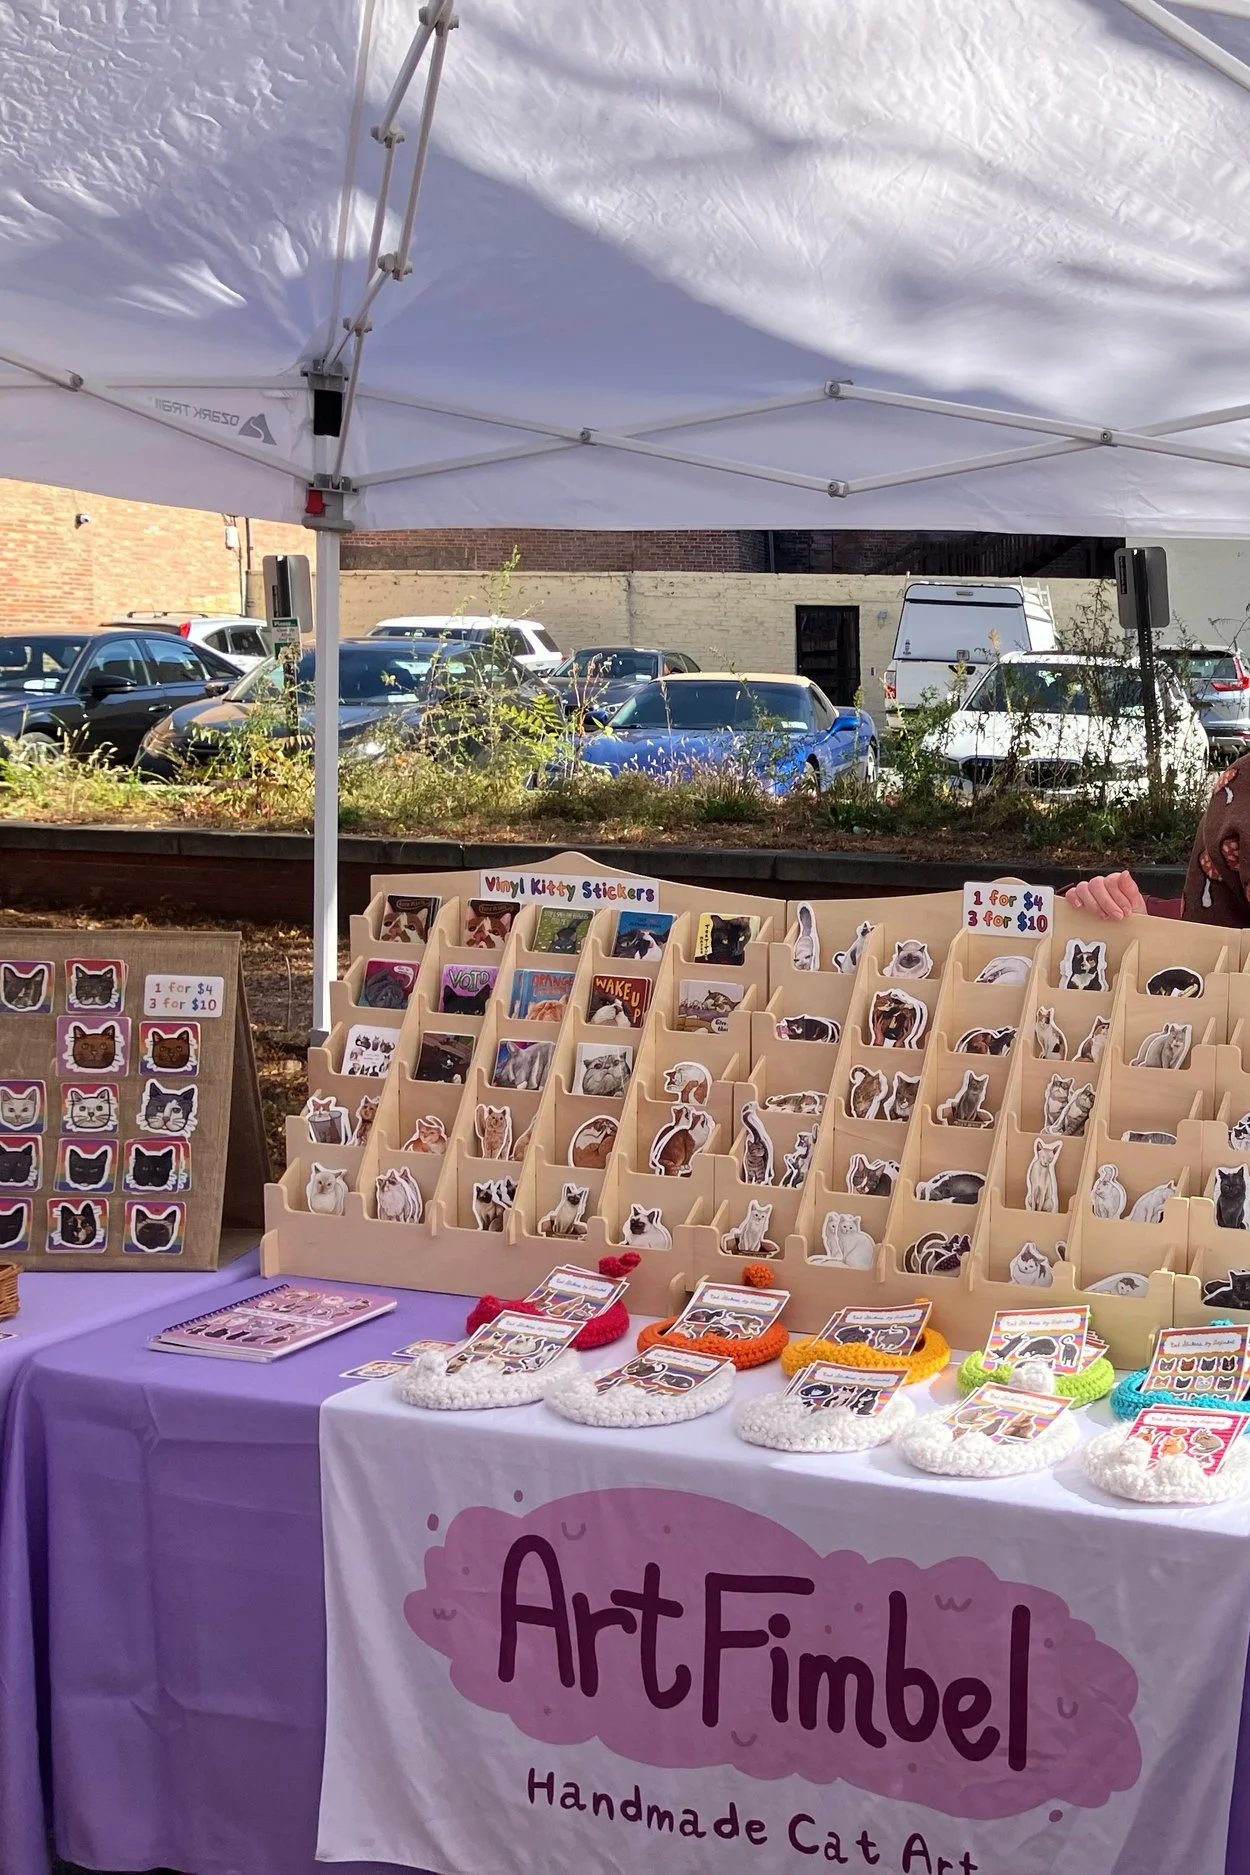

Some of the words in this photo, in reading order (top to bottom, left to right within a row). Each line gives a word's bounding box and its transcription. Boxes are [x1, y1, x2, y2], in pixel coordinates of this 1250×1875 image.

[484, 876, 525, 898] Vinyl
[531, 877, 576, 902] Kitty
[582, 881, 655, 902] Stickers
[973, 890, 983, 906] 1
[989, 889, 1017, 907] for
[1023, 891, 1044, 912] $4
[967, 910, 978, 926] 3
[983, 910, 1012, 928] for
[1017, 911, 1048, 933] $10
[155, 983, 162, 993] 1
[168, 982, 192, 994] for
[197, 982, 213, 995] $4
[449, 968, 490, 992] VOID
[596, 978, 632, 1001] WAKE
[149, 998, 157, 1009] 3
[163, 997, 186, 1010] for
[191, 997, 217, 1012] $10
[499, 1534, 1030, 1772] ArtFimbel
[528, 1767, 768, 1846] Handmade
[788, 1813, 880, 1865] Cat
[902, 1832, 978, 1875] Art
